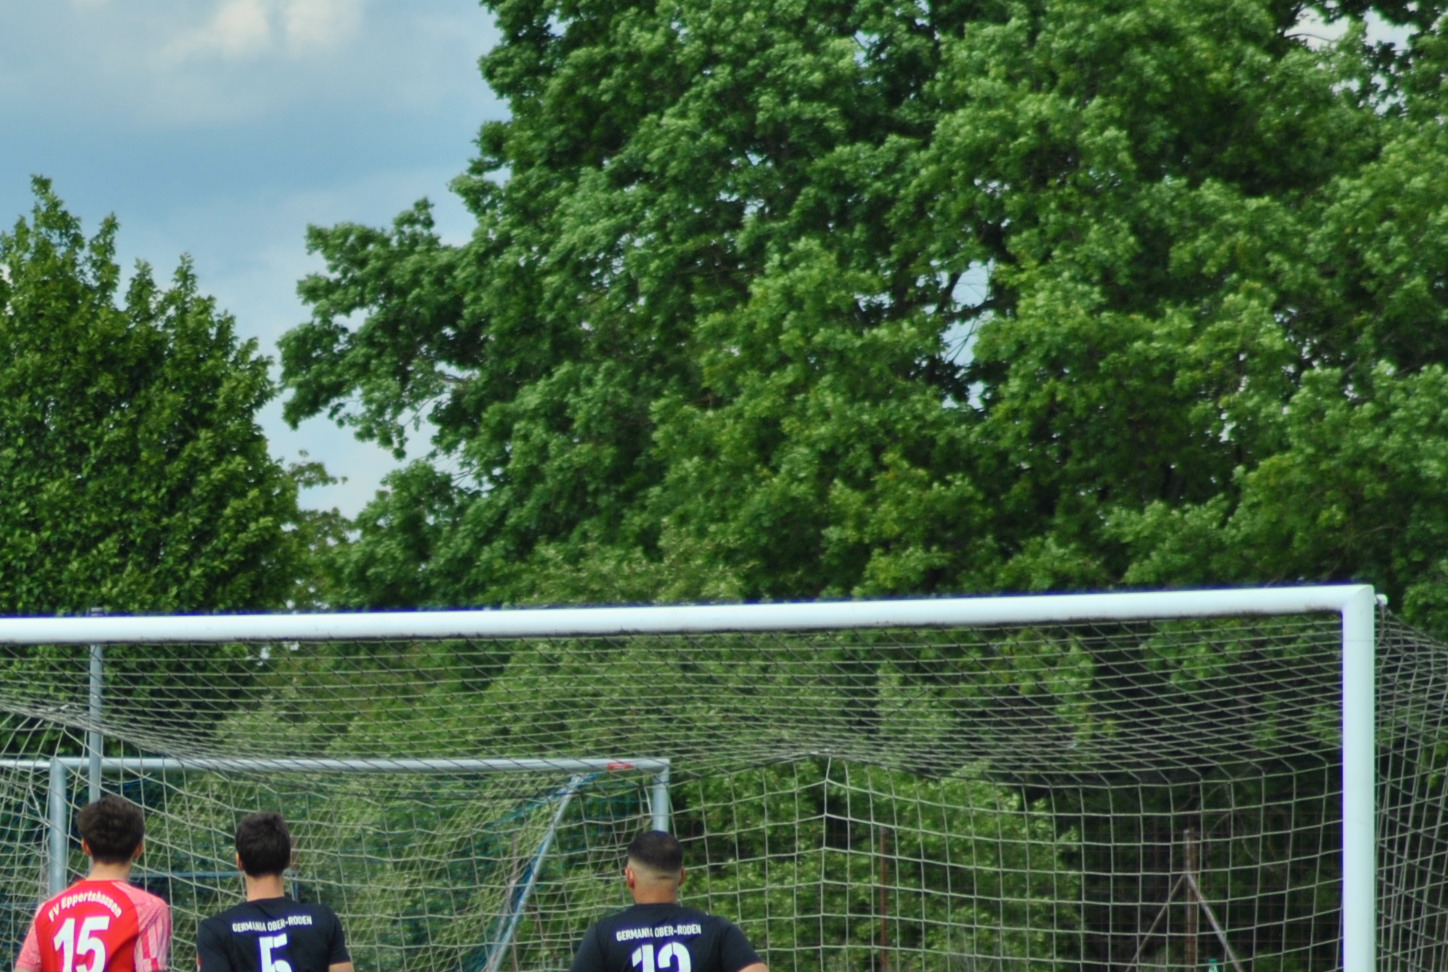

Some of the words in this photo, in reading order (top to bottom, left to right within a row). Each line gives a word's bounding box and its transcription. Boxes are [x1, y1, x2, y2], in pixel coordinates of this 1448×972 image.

[232, 921, 267, 933] GERMANIA
[267, 914, 312, 932] OBER-RODEN
[616, 927, 654, 942] GERMANIA
[654, 923, 702, 938] OBER-RODEN
